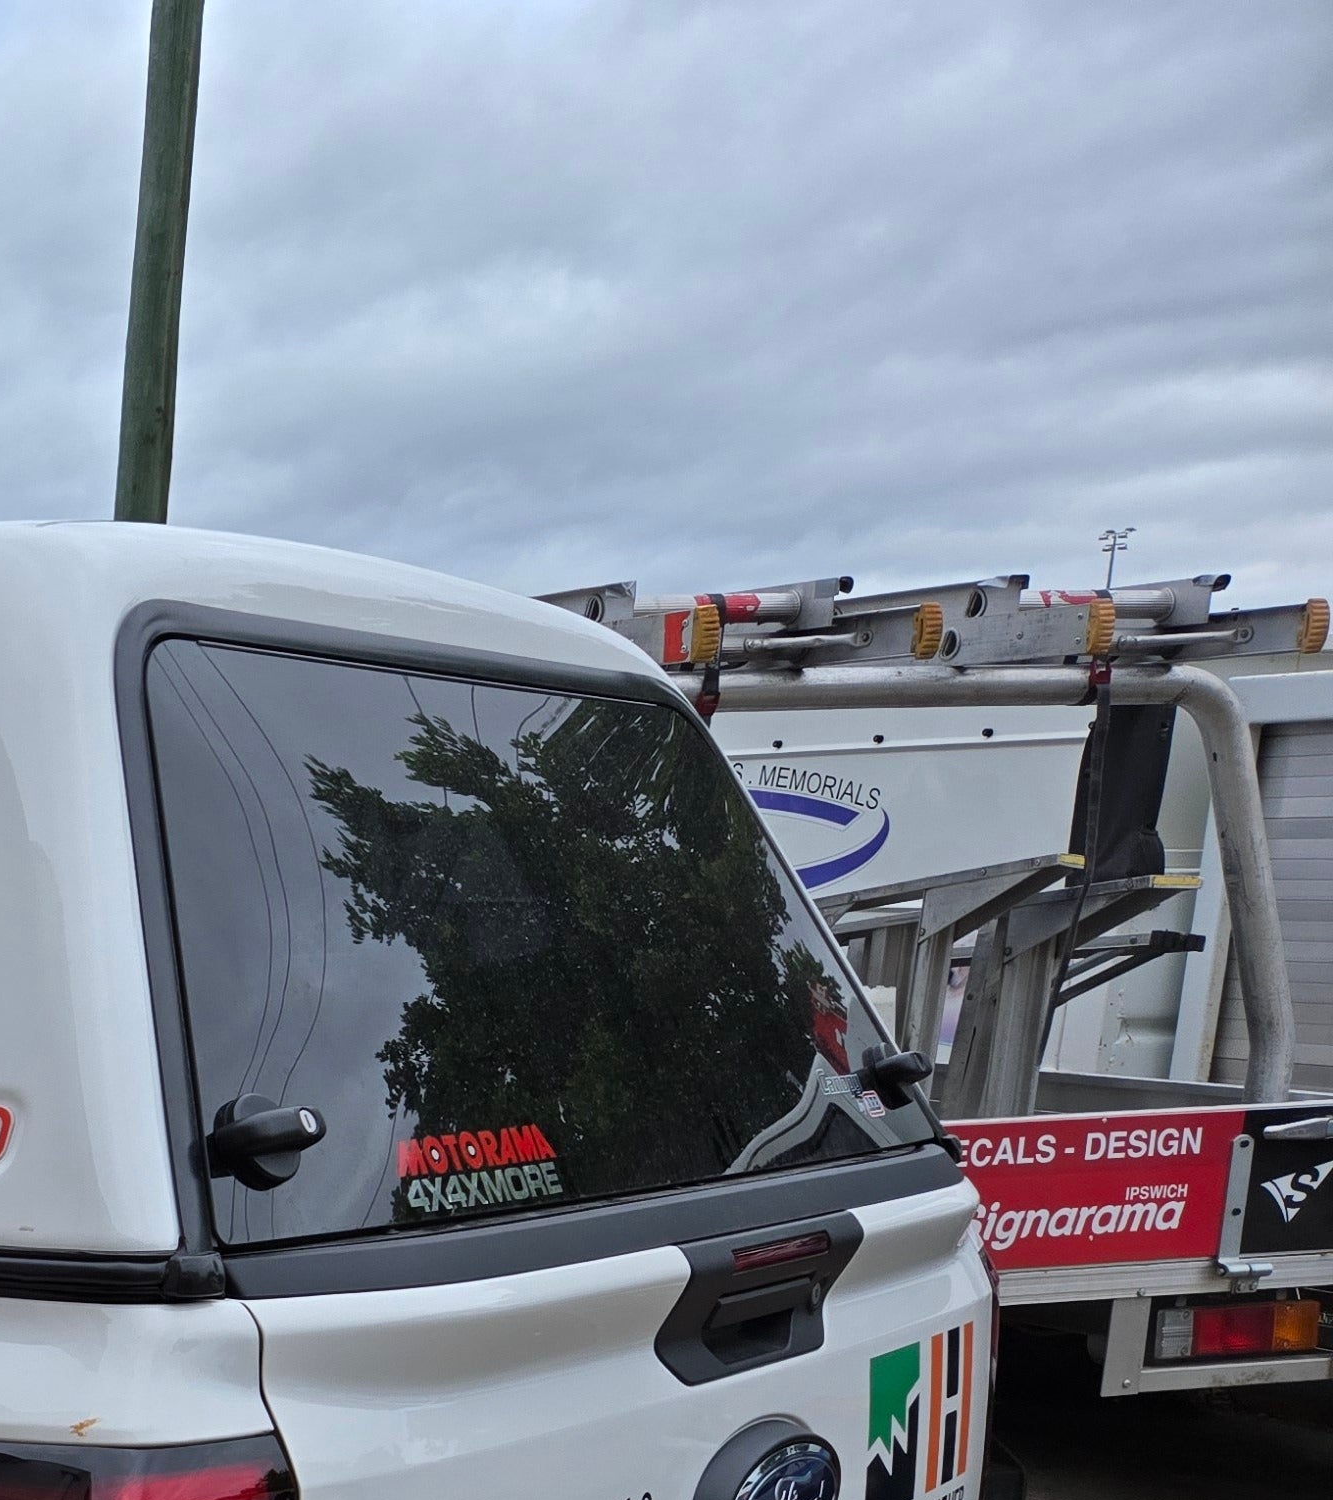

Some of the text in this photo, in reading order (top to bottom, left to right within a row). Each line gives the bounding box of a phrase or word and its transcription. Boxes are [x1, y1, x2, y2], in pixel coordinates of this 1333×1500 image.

[758, 764, 881, 810] MEMORIALS
[397, 1123, 557, 1178] MOTORAMA
[1084, 1127, 1203, 1161] DESIGN
[407, 1161, 563, 1213] 4X4XMORE
[1125, 1184, 1189, 1201] IPSWICH
